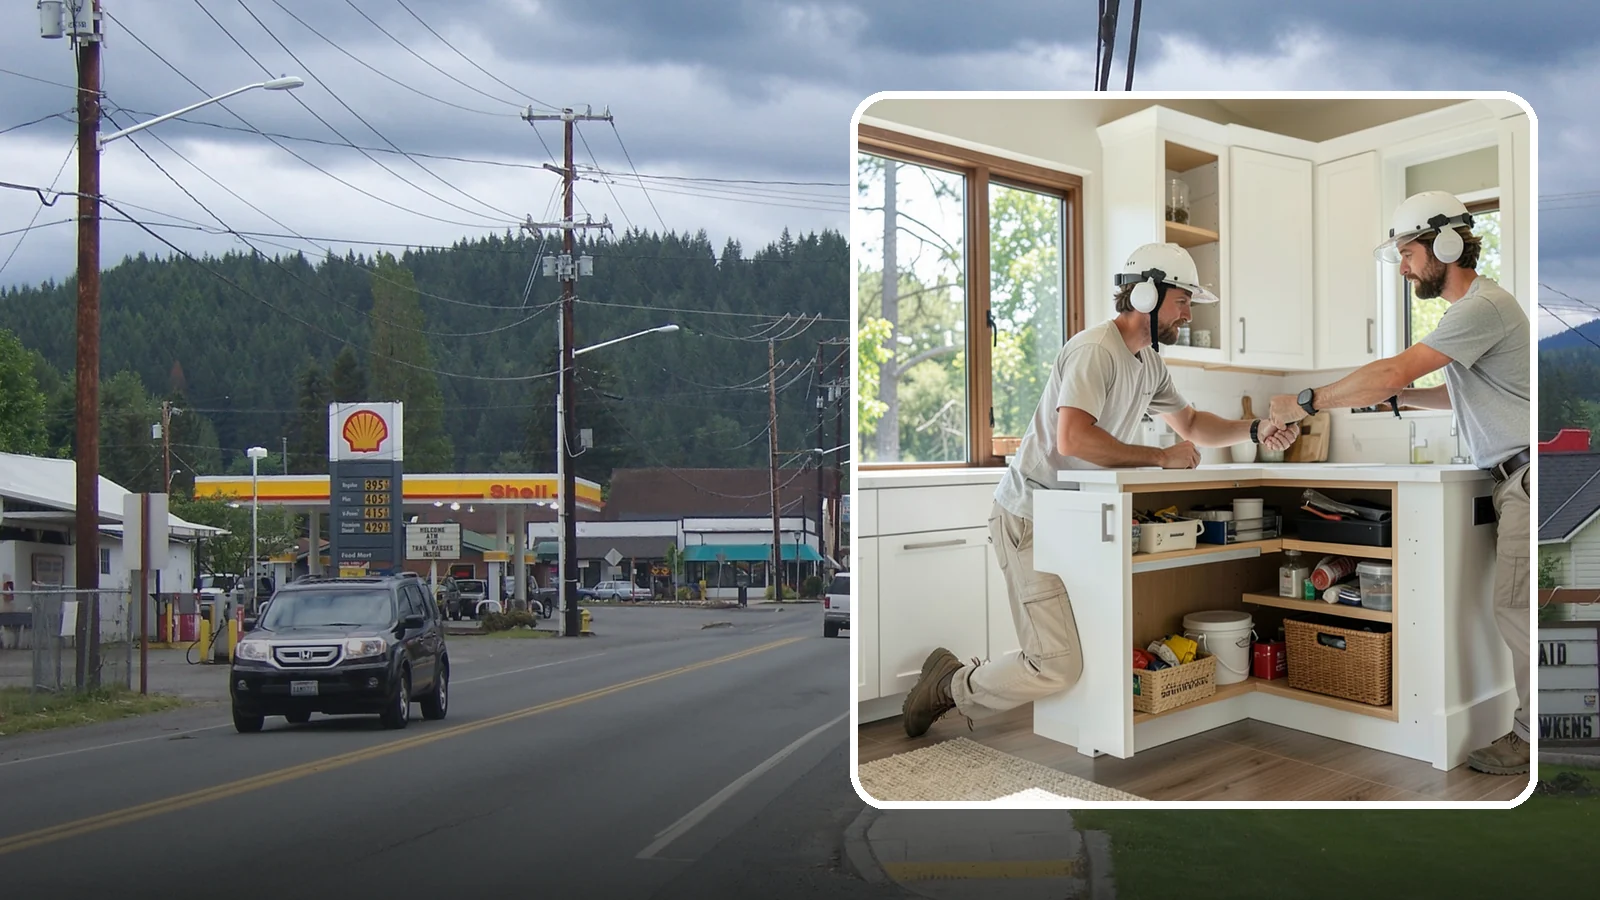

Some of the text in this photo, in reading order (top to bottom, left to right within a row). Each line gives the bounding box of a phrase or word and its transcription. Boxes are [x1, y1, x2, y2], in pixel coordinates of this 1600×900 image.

[366, 480, 383, 490] 395
[490, 484, 547, 498] Shell
[366, 494, 383, 504] 405
[366, 508, 383, 518] 415
[366, 523, 383, 532] 429
